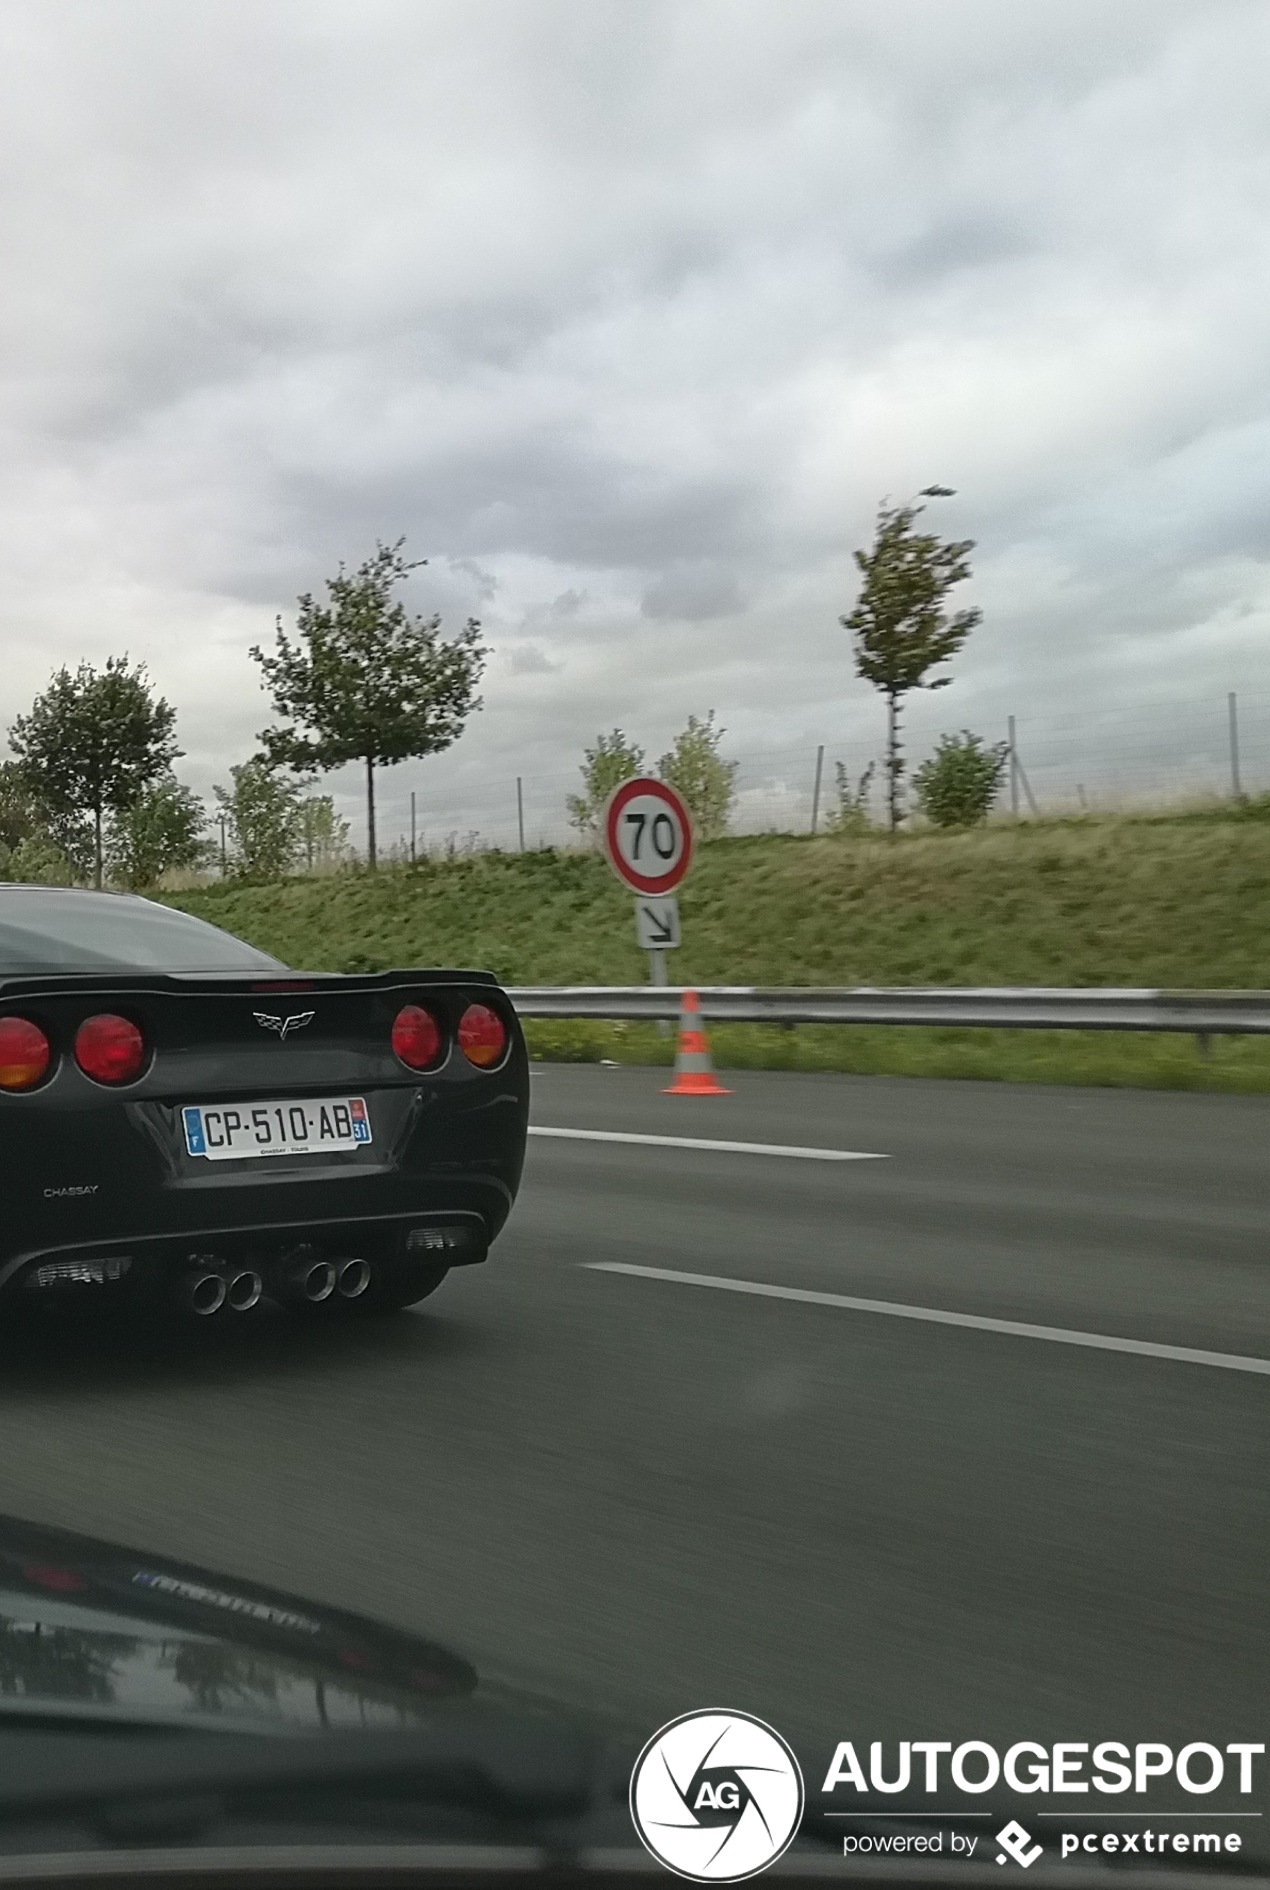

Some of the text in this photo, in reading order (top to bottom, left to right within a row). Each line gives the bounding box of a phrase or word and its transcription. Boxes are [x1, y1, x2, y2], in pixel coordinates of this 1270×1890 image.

[625, 813, 676, 860] 70
[203, 1104, 352, 1147] CP-510-AB
[353, 1123, 368, 1142] 31
[191, 1136, 199, 1148] F
[43, 1185, 99, 1198] CHASSAY
